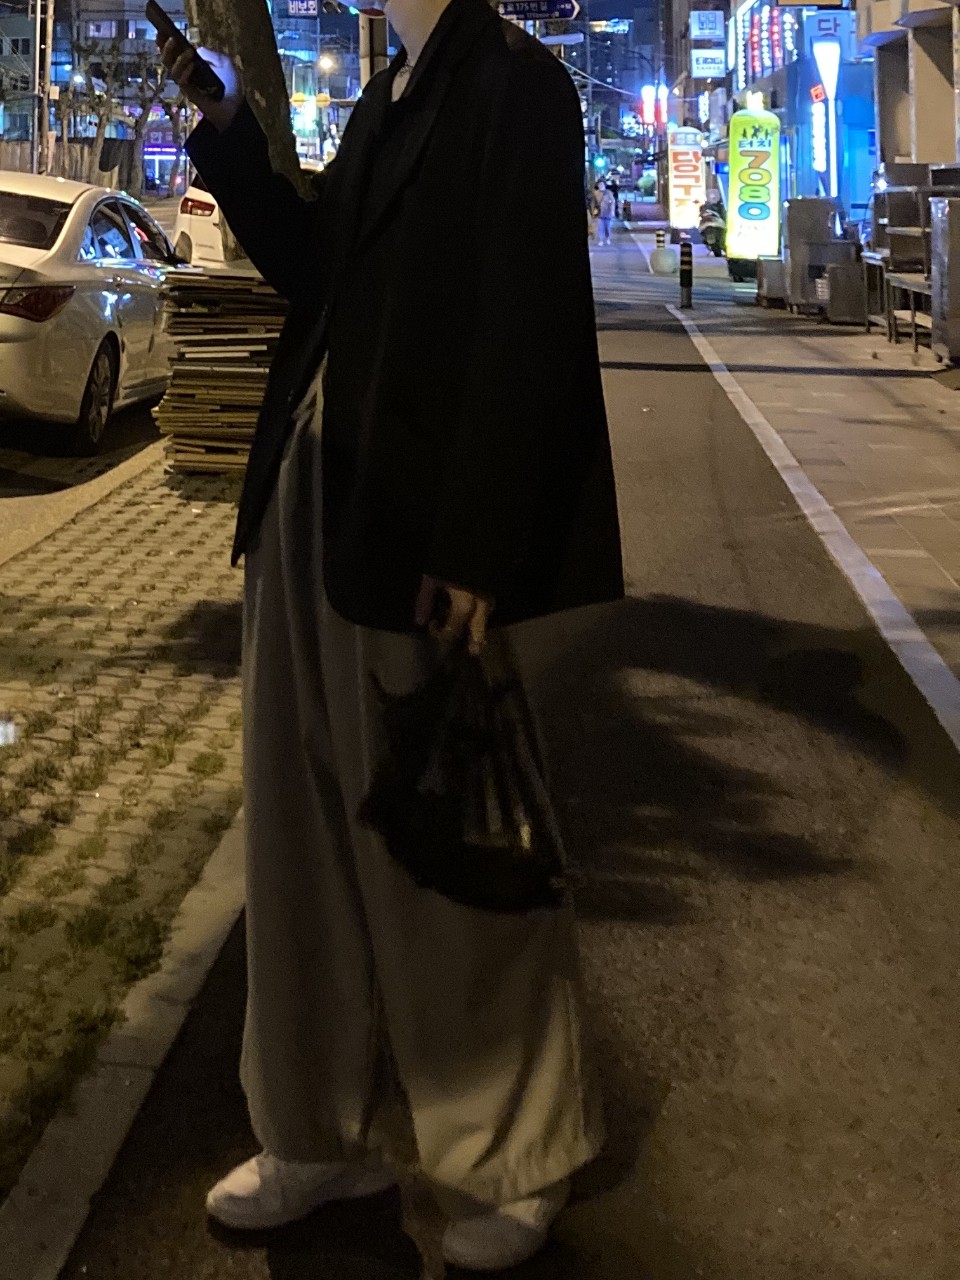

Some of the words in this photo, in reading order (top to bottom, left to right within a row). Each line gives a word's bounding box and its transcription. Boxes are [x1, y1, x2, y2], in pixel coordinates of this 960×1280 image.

[289, 0, 315, 14] 비보호
[738, 138, 771, 148] 터치
[738, 150, 772, 221] 7080
